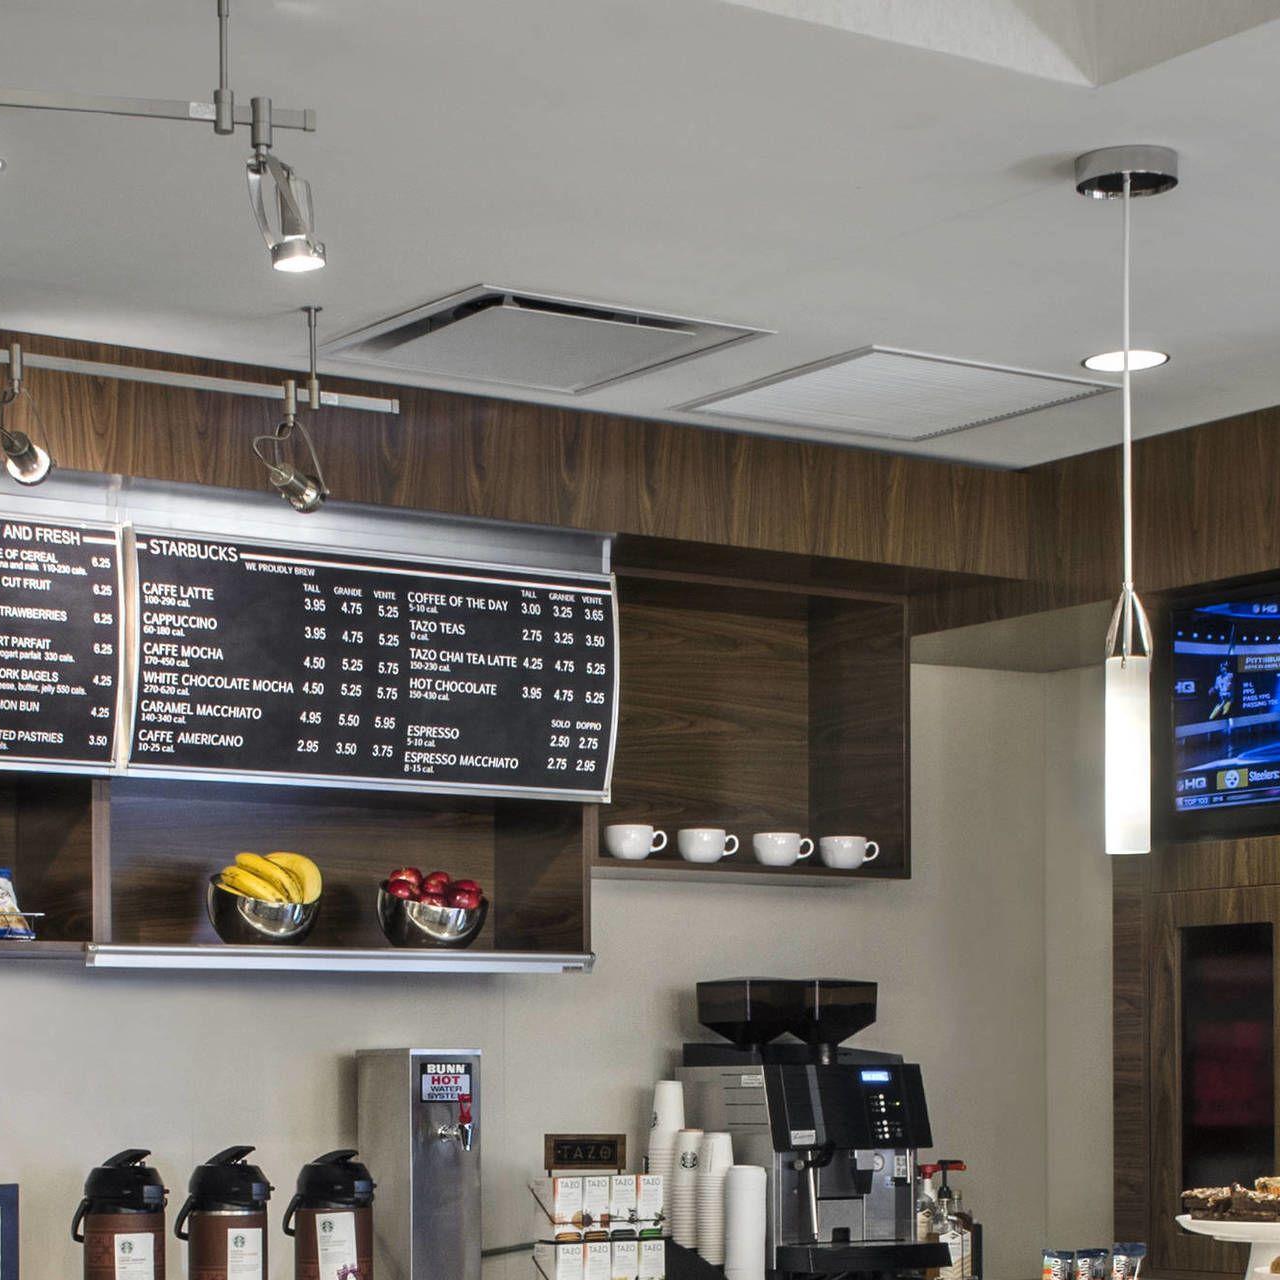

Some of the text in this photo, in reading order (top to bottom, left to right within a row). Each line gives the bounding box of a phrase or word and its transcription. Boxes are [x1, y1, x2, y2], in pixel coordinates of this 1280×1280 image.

[4, 525, 32, 540] AND
[36, 528, 81, 546] FRESH
[5, 548, 18, 560] OF
[20, 550, 58, 563] CEREAL
[92, 557, 111, 568] 6.25
[150, 539, 238, 562] STARBUCKS
[2, 577, 22, 588] CUT
[23, 579, 52, 591] FRUIT
[93, 584, 112, 596] 6.25
[143, 582, 399, 618] CAFFE LATTE 3.95 4.75 5.25
[408, 591, 604, 622] COFFEE OF THE DAY 3.00 3.25 3.65
[94, 613, 113, 625] 6.25
[144, 612, 399, 647] CAPPUCCINO 3.95 4.75 5.25
[11, 637, 52, 650] PARFAIT
[94, 643, 113, 655] 6.25
[410, 648, 518, 668] TAZO CHAI TEA LATTE
[21, 670, 59, 682] BAGELS
[93, 675, 112, 687] 4.25
[144, 671, 398, 700] WHITE CHOCOLATE MOCHA 4.50 5.25 5.75
[410, 678, 497, 696] HOT CHOCOLATE
[20, 701, 40, 712] BUN
[91, 707, 110, 718] 4.25
[18, 731, 64, 744] PASTRIES
[89, 736, 107, 746] 3.50
[139, 729, 393, 758] CAFFE AMERICANO 2.95 3.50 3.75
[405, 752, 596, 772] ESPRESSO MACCHIATO 2.75 2.95
[1249, 769, 1280, 783] Steelers:
[427, 1064, 465, 1074] BUNN
[432, 1076, 460, 1085] HOT
